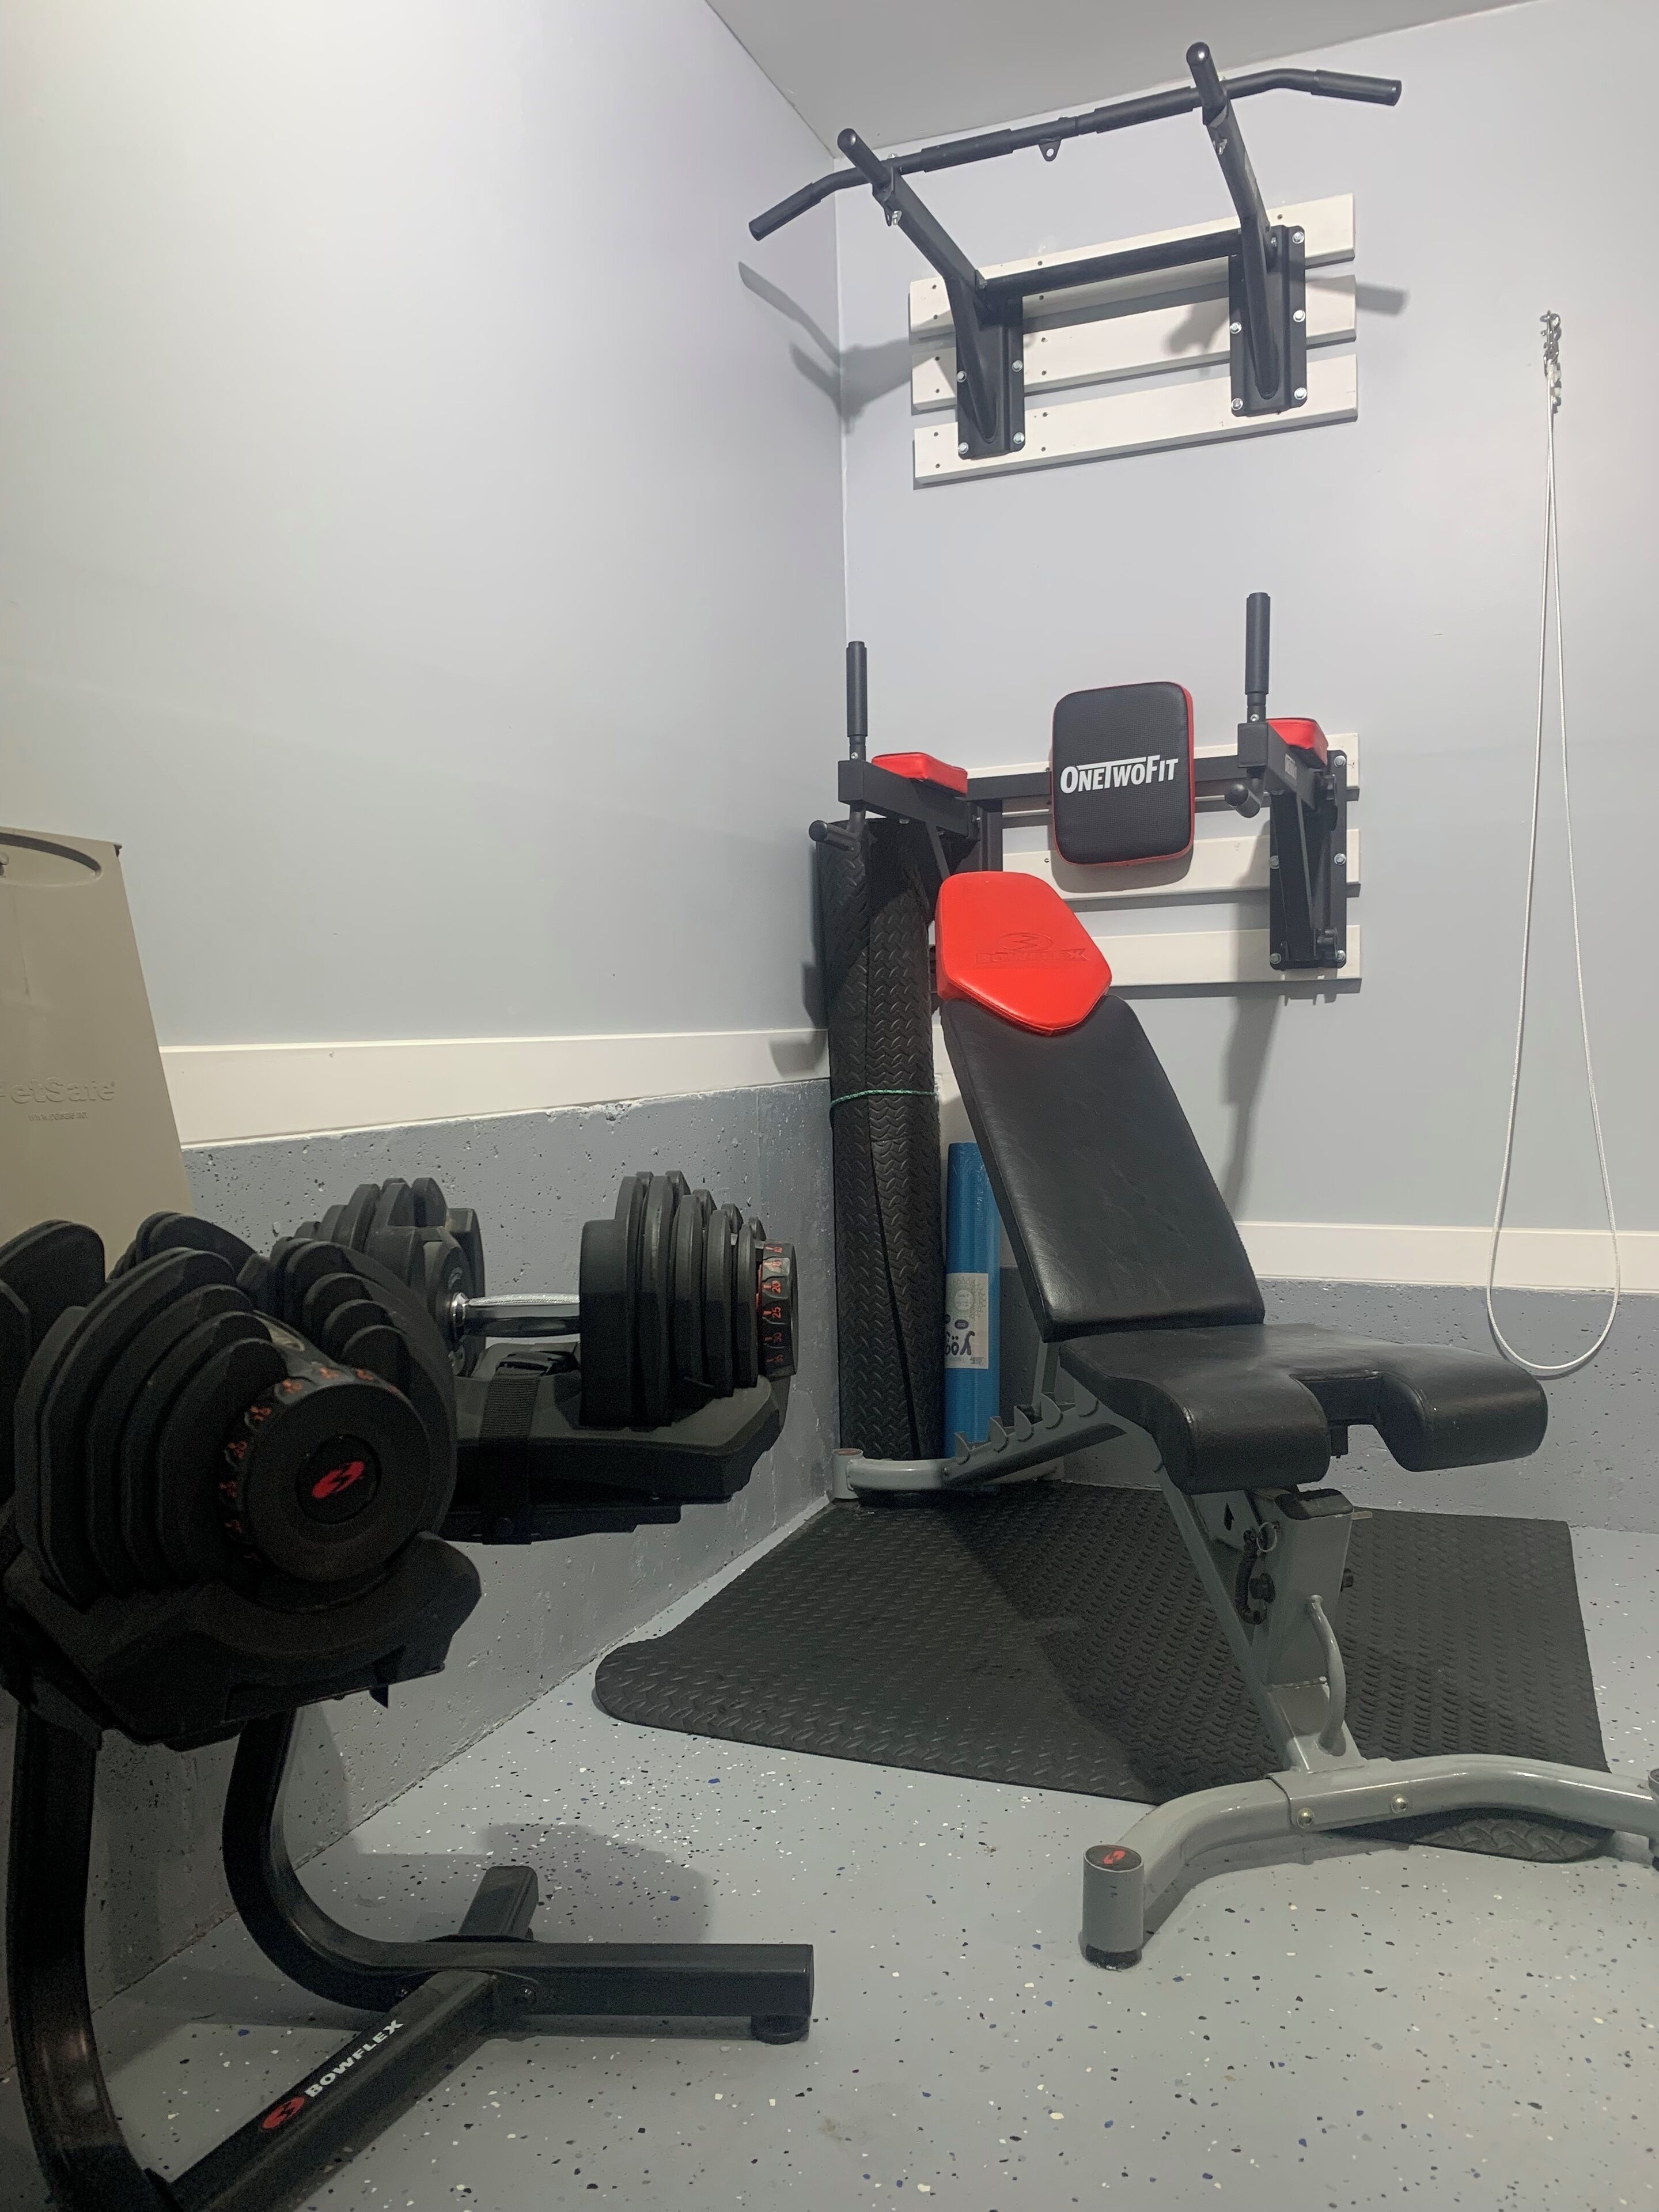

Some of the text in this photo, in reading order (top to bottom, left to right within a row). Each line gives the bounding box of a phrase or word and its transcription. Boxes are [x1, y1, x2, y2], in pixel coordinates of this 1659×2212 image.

[975, 948, 1089, 964] BOWFLEX
[0, 1076, 115, 1104] etSafe
[771, 1280, 782, 1294] 20
[772, 1306, 782, 1319] 25
[304, 2020, 404, 2097] BOWFLEX
